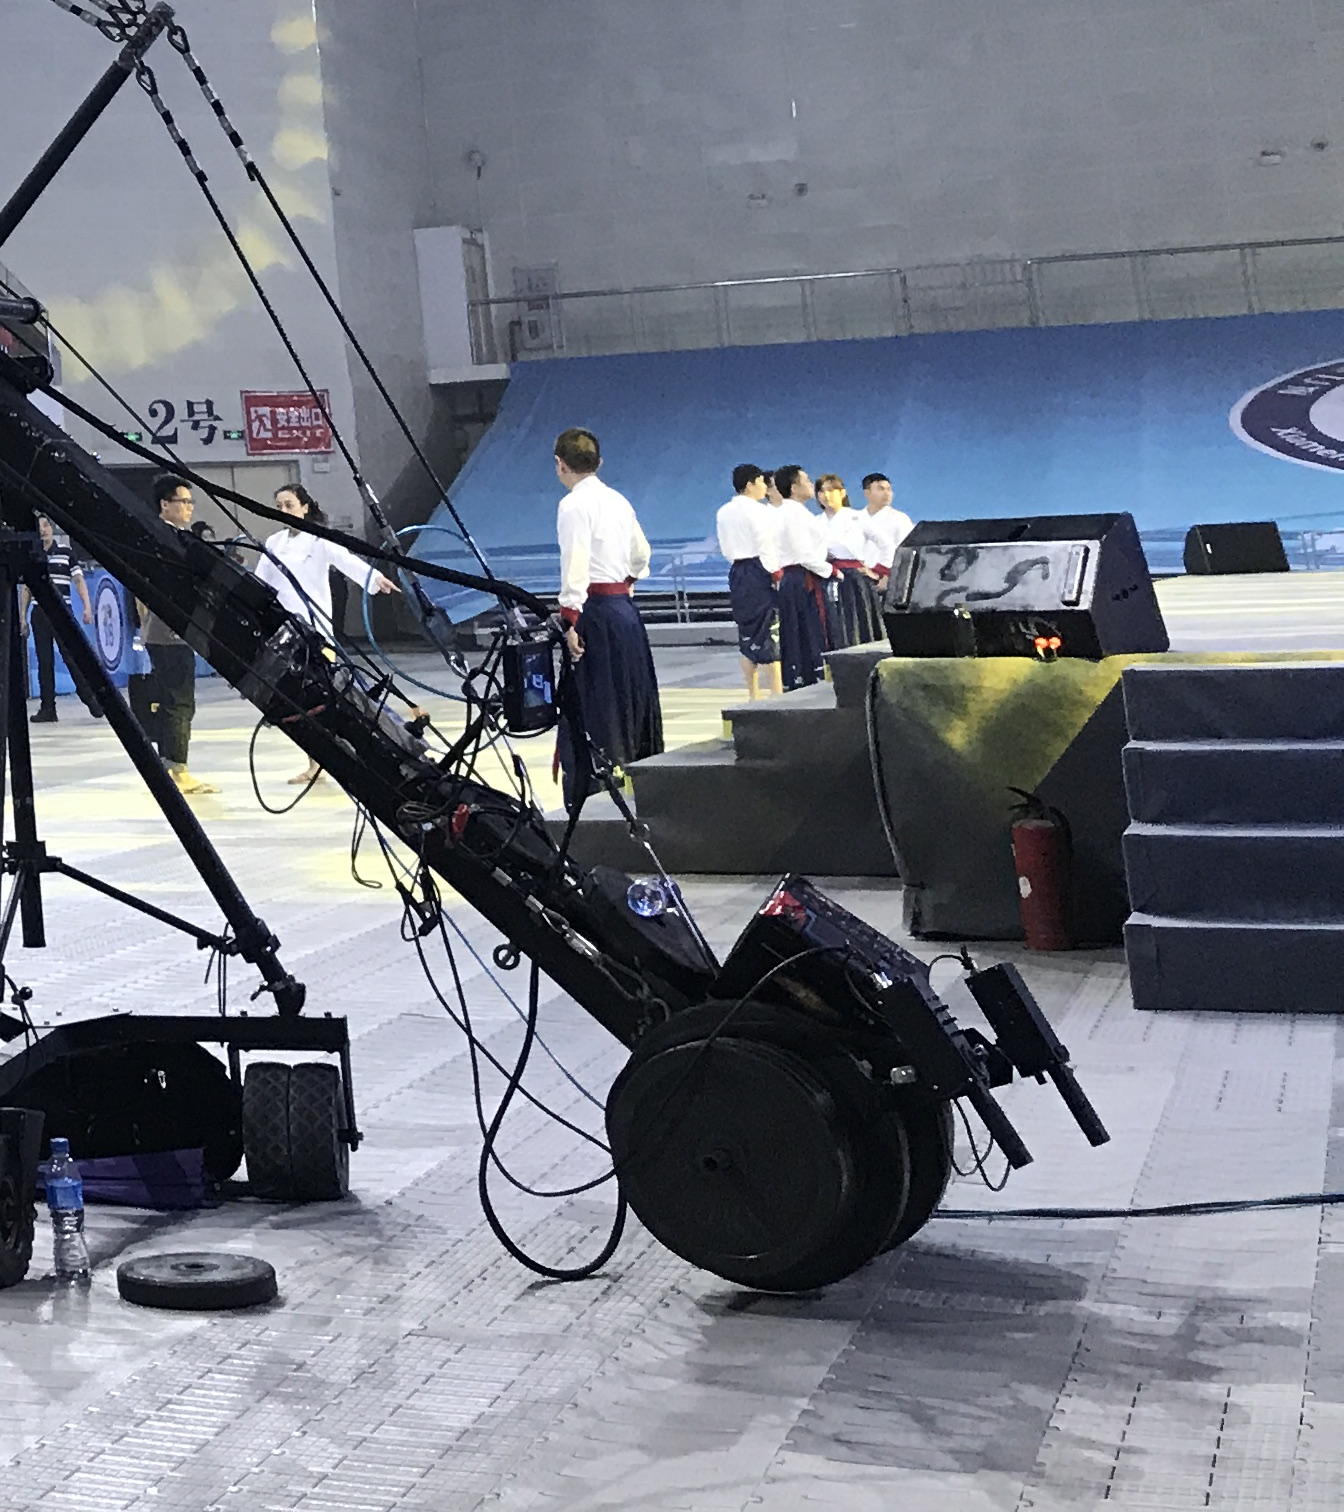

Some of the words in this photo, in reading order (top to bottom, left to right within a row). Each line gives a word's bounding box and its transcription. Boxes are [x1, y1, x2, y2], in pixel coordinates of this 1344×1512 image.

[148, 398, 224, 446] 2号
[276, 406, 324, 428] 安全出口
[277, 428, 325, 439] EXIT
